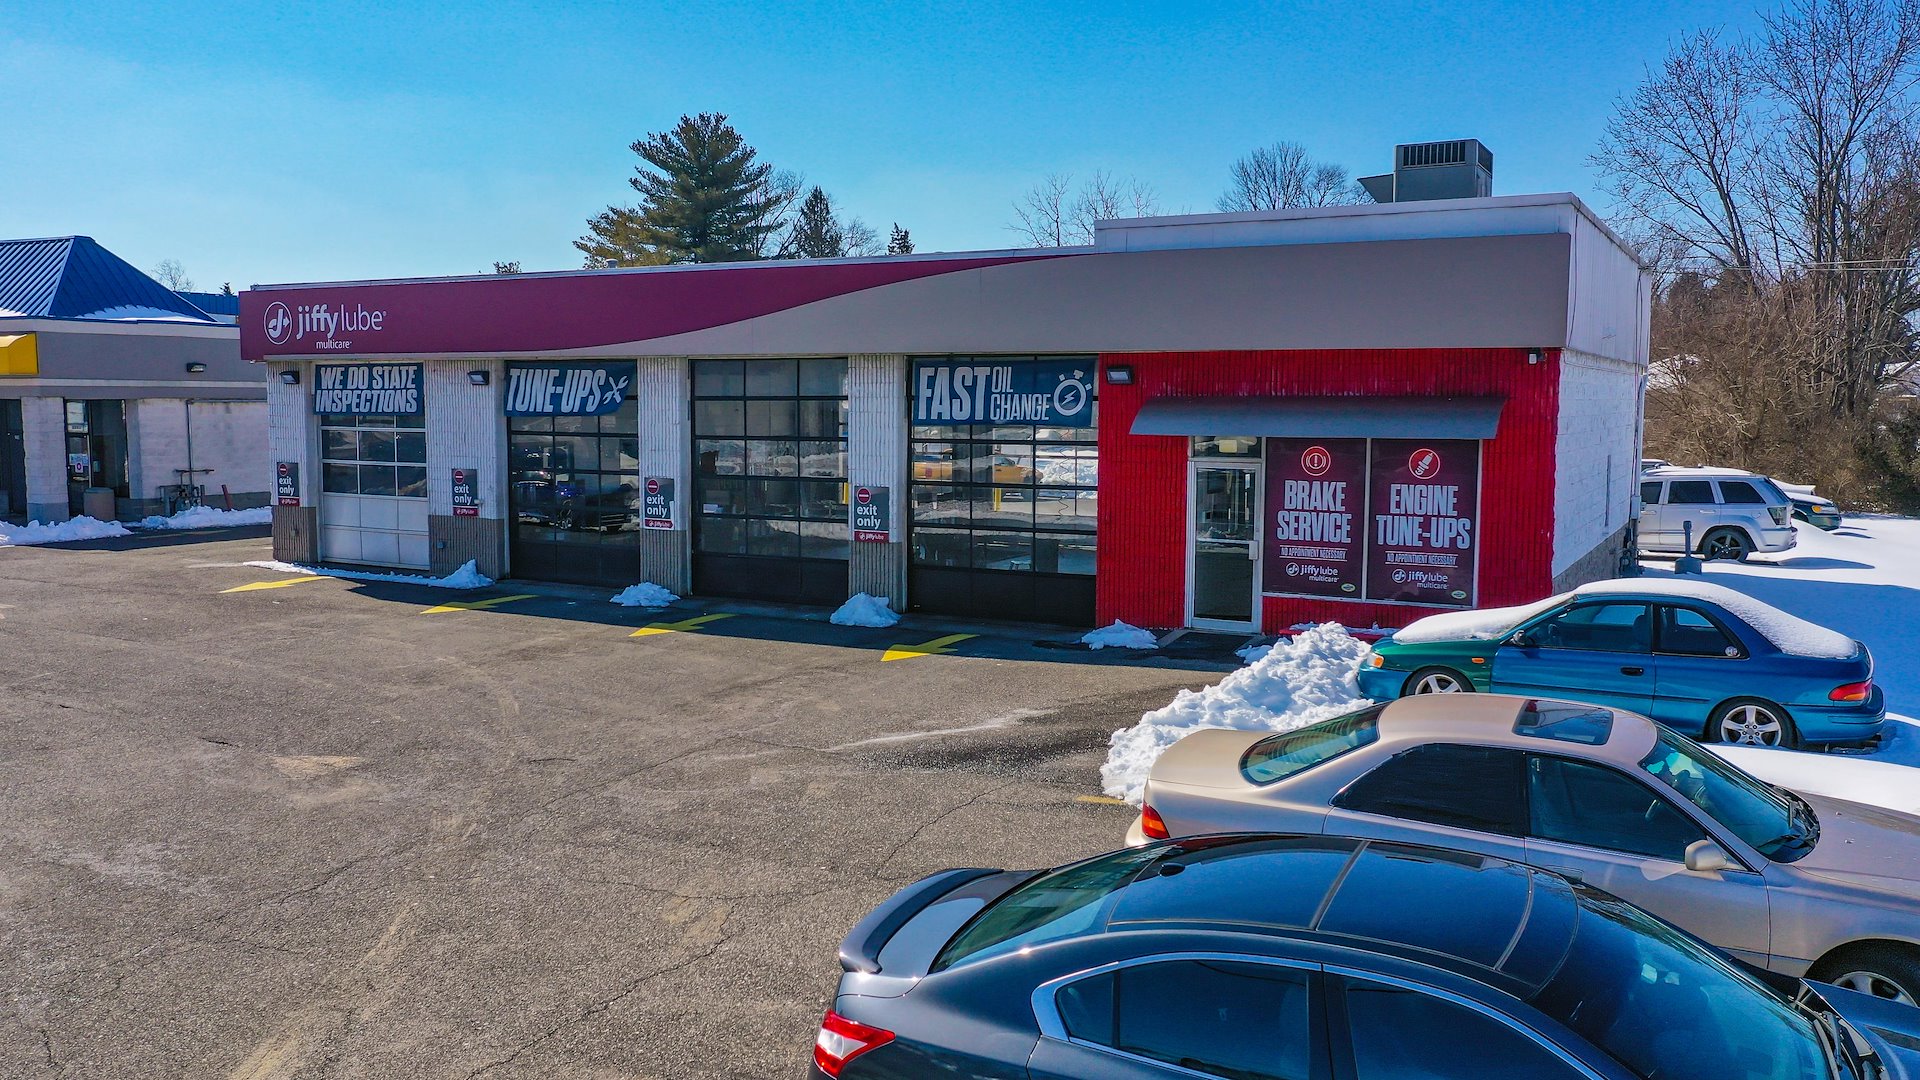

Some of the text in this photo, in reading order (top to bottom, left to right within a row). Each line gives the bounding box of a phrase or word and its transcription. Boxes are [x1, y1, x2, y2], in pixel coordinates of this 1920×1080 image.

[296, 304, 338, 340] jiffy
[316, 340, 350, 349] multicare
[320, 366, 418, 389] WE DO STATE
[992, 366, 1014, 393] OIL
[506, 368, 607, 413] TUNE-UPS
[918, 366, 991, 421] FAST
[315, 389, 418, 413] INSPECTIONS
[990, 393, 1051, 421] CHANGE
[279, 476, 292, 485] exit
[453, 484, 470, 493] exit
[279, 485, 295, 496] only
[454, 494, 472, 505] only
[646, 494, 665, 505] exit
[1284, 479, 1347, 511] BRAKE
[1390, 483, 1459, 516] ENGINE
[646, 505, 668, 518] only
[856, 504, 878, 515] exit
[856, 515, 881, 530] only
[1277, 510, 1352, 544] SERVICE
[1376, 515, 1471, 549] TUNE-UPS
[1281, 547, 1347, 560] NO APPOINTMENT NECESSARY
[1387, 553, 1457, 565] NO APPOINTMENT NECESSARY
